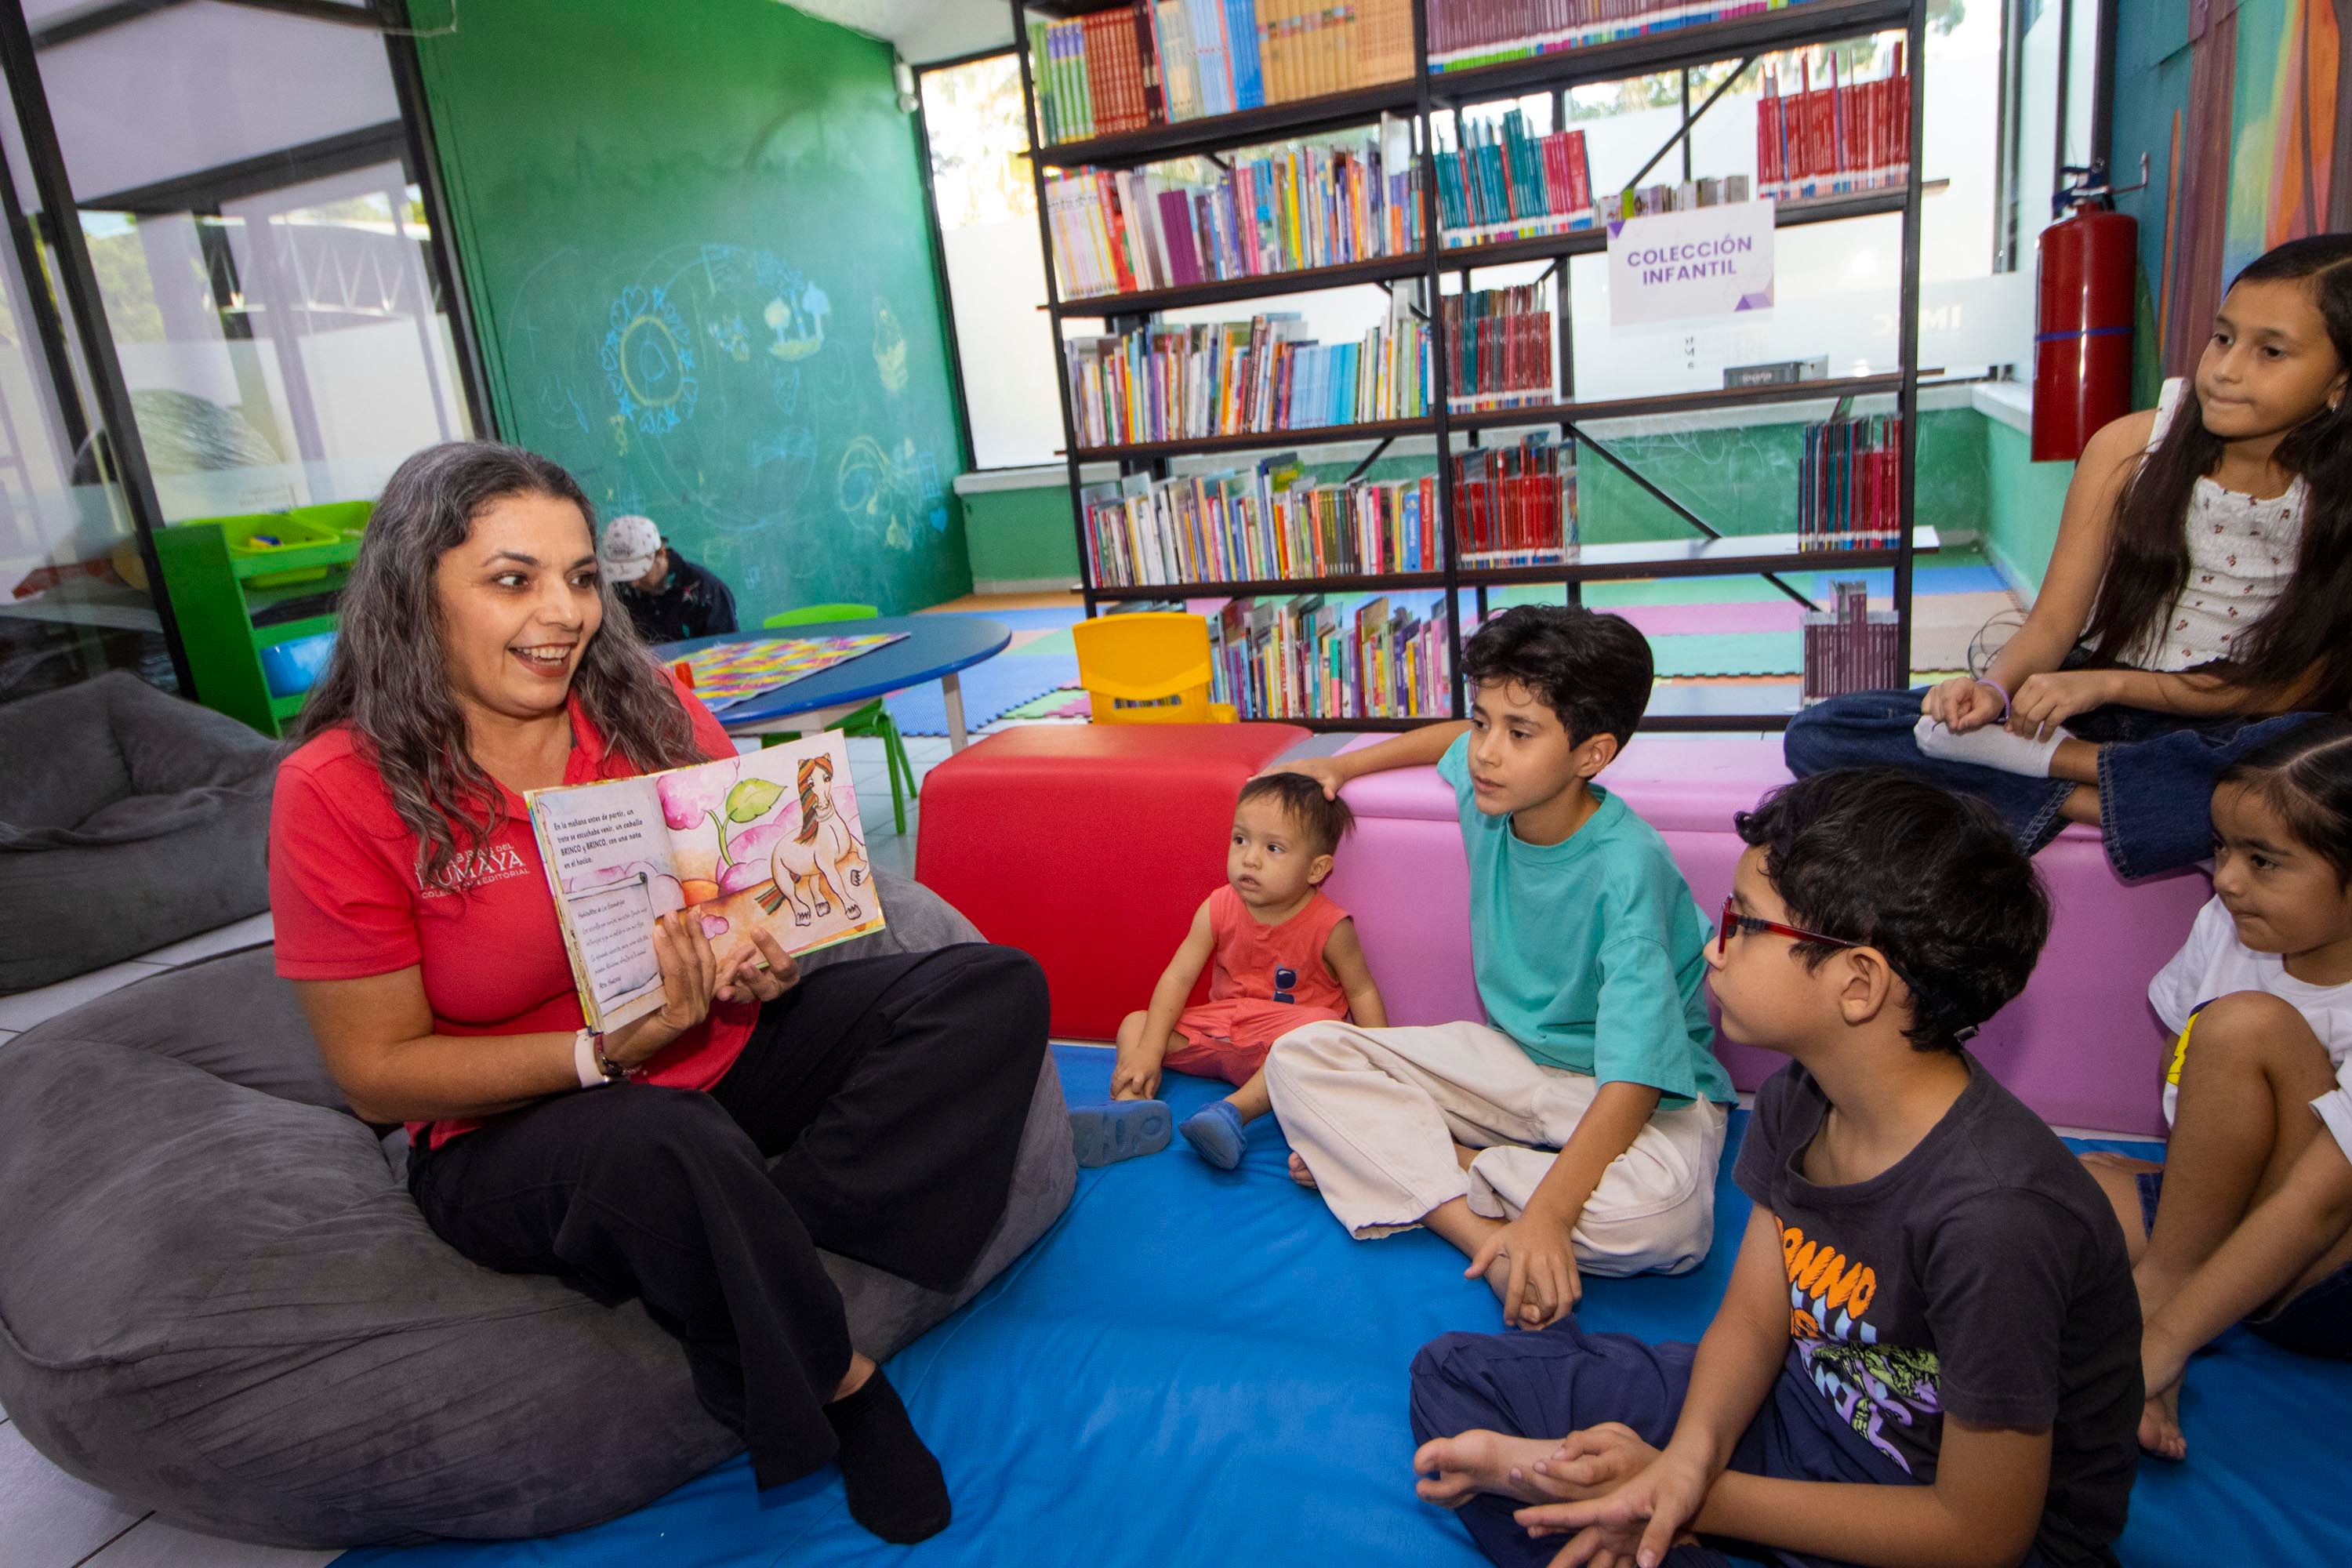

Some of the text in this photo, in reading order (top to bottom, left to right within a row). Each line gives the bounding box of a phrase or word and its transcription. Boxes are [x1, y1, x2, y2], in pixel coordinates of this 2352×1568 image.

[1628, 234, 1752, 267] COLECCIÓN
[1642, 260, 1737, 285] INFANTIL
[554, 822, 561, 831] En
[568, 818, 587, 828] mañana
[623, 818, 643, 829] caballo
[495, 843, 515, 853] DEL
[561, 844, 582, 856] BRINCO
[608, 837, 618, 846] con
[482, 868, 530, 884] EDITORIAL
